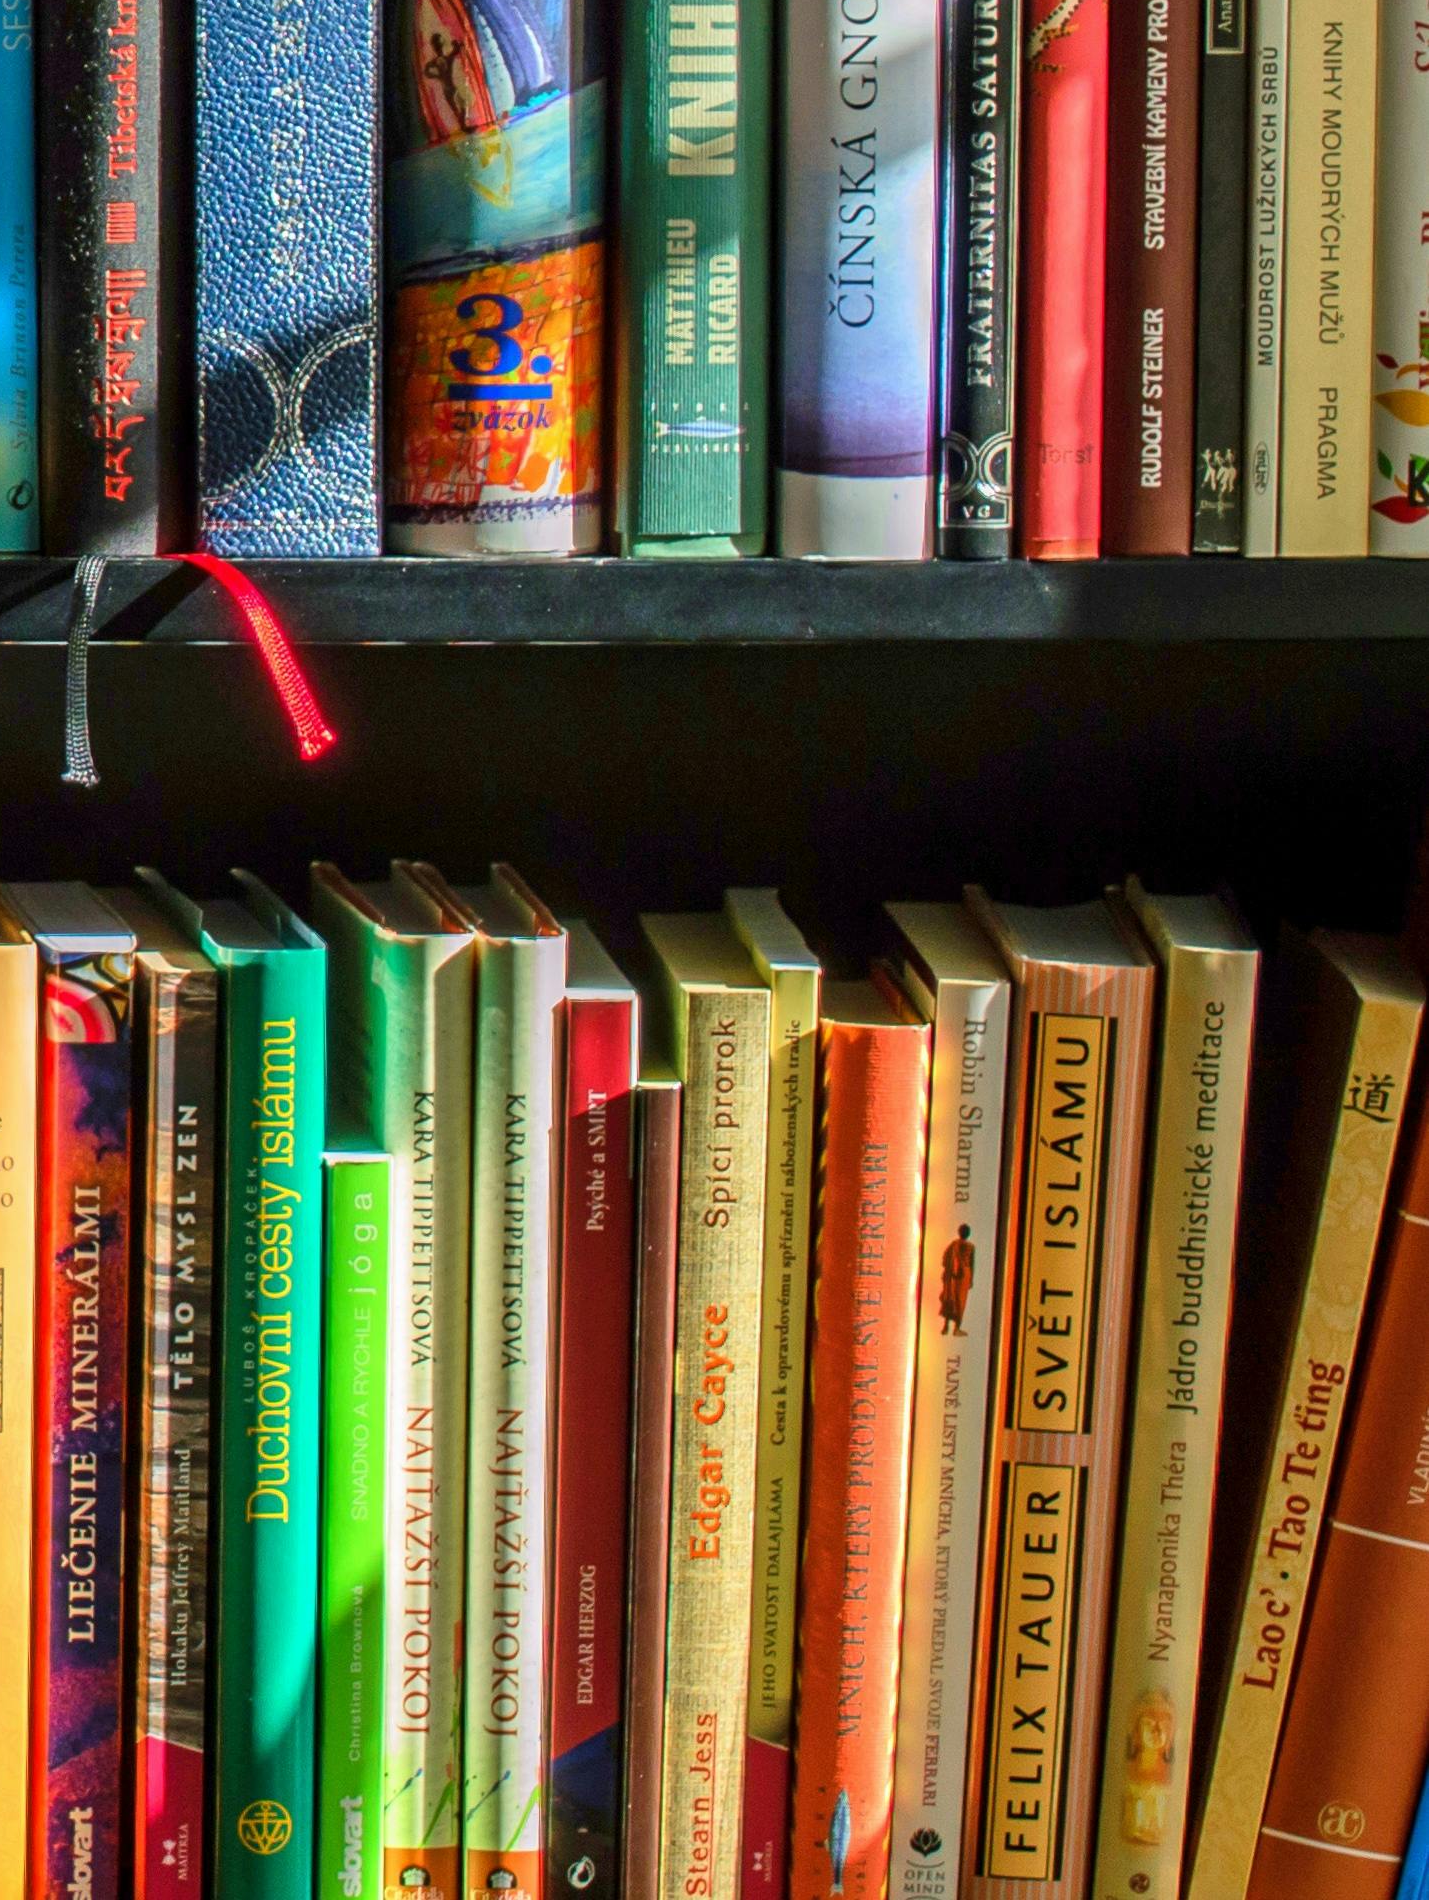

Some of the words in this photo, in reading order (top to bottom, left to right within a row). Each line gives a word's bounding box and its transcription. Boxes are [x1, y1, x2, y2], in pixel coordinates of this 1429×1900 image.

[825, 127, 880, 327] ČÍNSKÁ
[1141, 307, 1166, 397] STEINER
[1139, 404, 1164, 486] RUDOLF
[1042, 1031, 1091, 1249] ISLÁMU
[63, 1183, 103, 1431] MINERÁLMI
[692, 1303, 735, 1426] Cayce
[1027, 1276, 1072, 1413] SVĚT
[61, 1450, 100, 1641] LIEČENIE
[688, 1443, 730, 1560] Edgar
[1016, 1487, 1062, 1677] TAUER
[1004, 1701, 1047, 1853] FELIX
